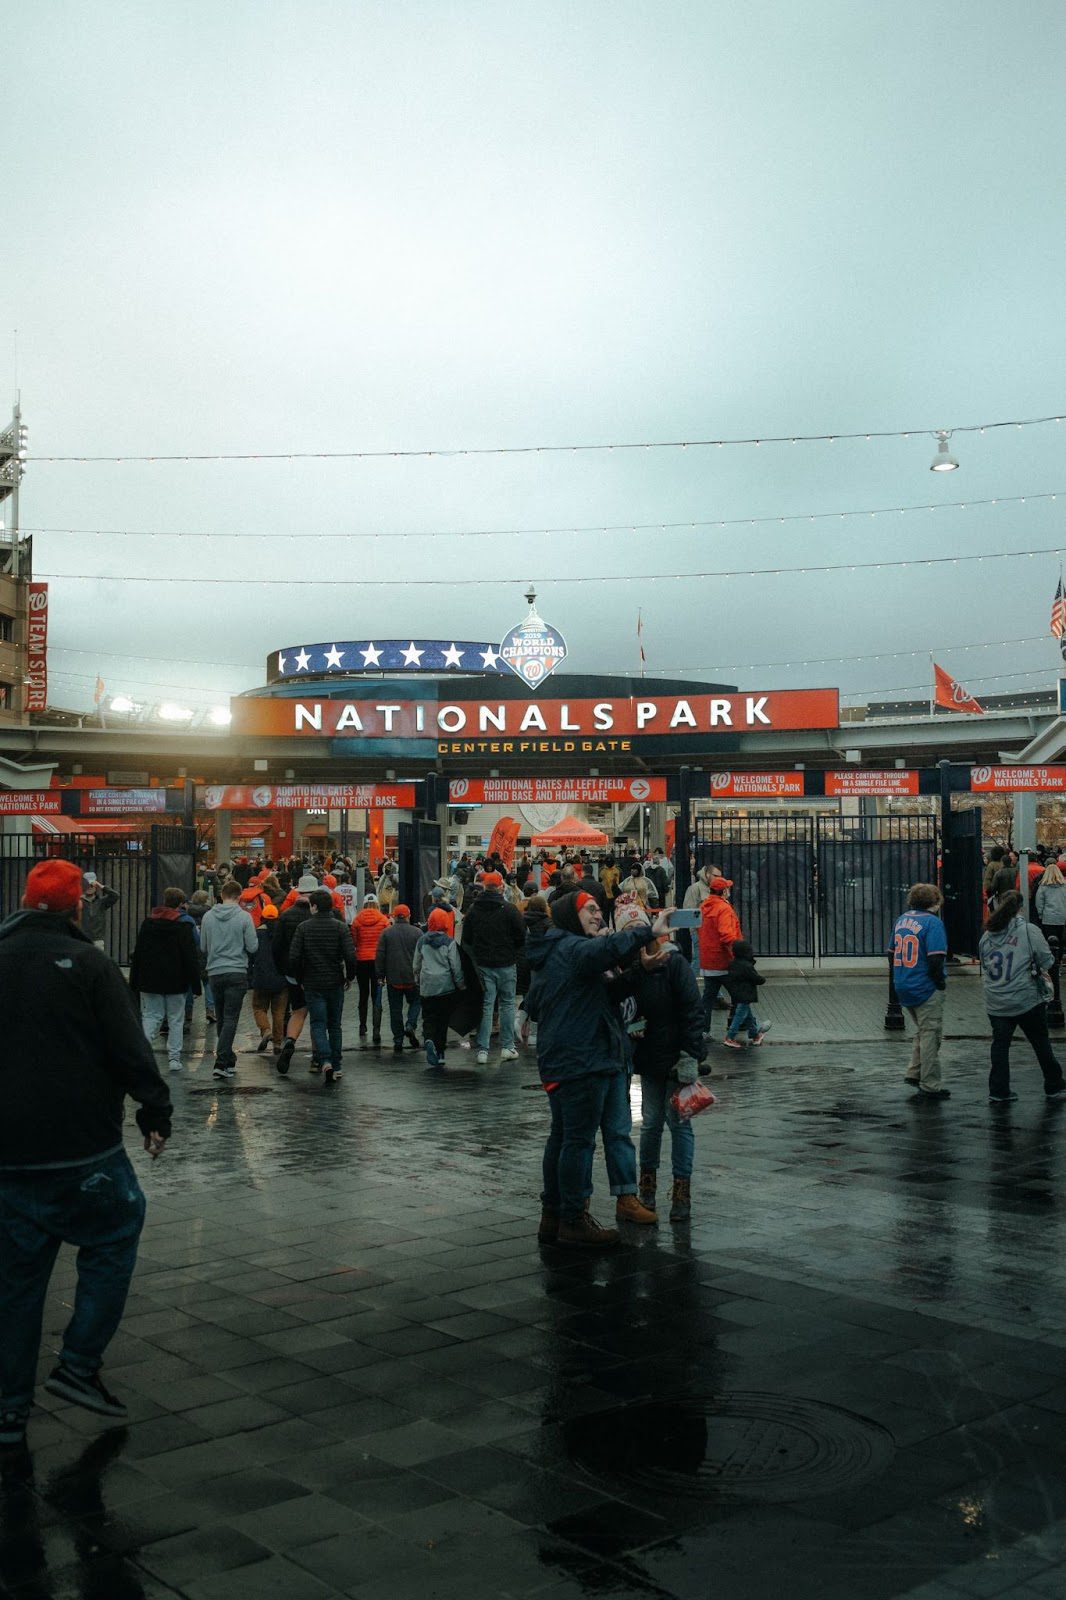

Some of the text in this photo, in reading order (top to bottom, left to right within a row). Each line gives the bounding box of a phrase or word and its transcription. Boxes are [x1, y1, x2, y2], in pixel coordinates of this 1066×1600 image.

[512, 637, 555, 646] WORLD
[502, 646, 565, 658] CHAMPIONS
[28, 614, 46, 709] TEAM STORE
[294, 696, 772, 733] NATIONALS PARK
[438, 740, 632, 753] CENTER FIELD GATE
[994, 769, 1048, 778] WELCOME TO
[483, 780, 626, 790] ADDITIONAL GATES AT LEFT FIELD,
[733, 775, 785, 784] WELCOME TO
[994, 778, 1063, 787] NATIONALS PARK
[276, 785, 365, 796] ADDITIONAL GATES AT
[733, 784, 800, 793] NATIONALS PARK
[0, 794, 45, 802] WELCOME TO
[483, 790, 608, 801] THIRD BASE AND HOME PLATE
[0, 801, 59, 810] NATIONALS PARK
[276, 796, 397, 807] RIGHT FIELD AND FIRST BASE
[893, 934, 919, 968] 20
[989, 951, 1014, 981] 31
